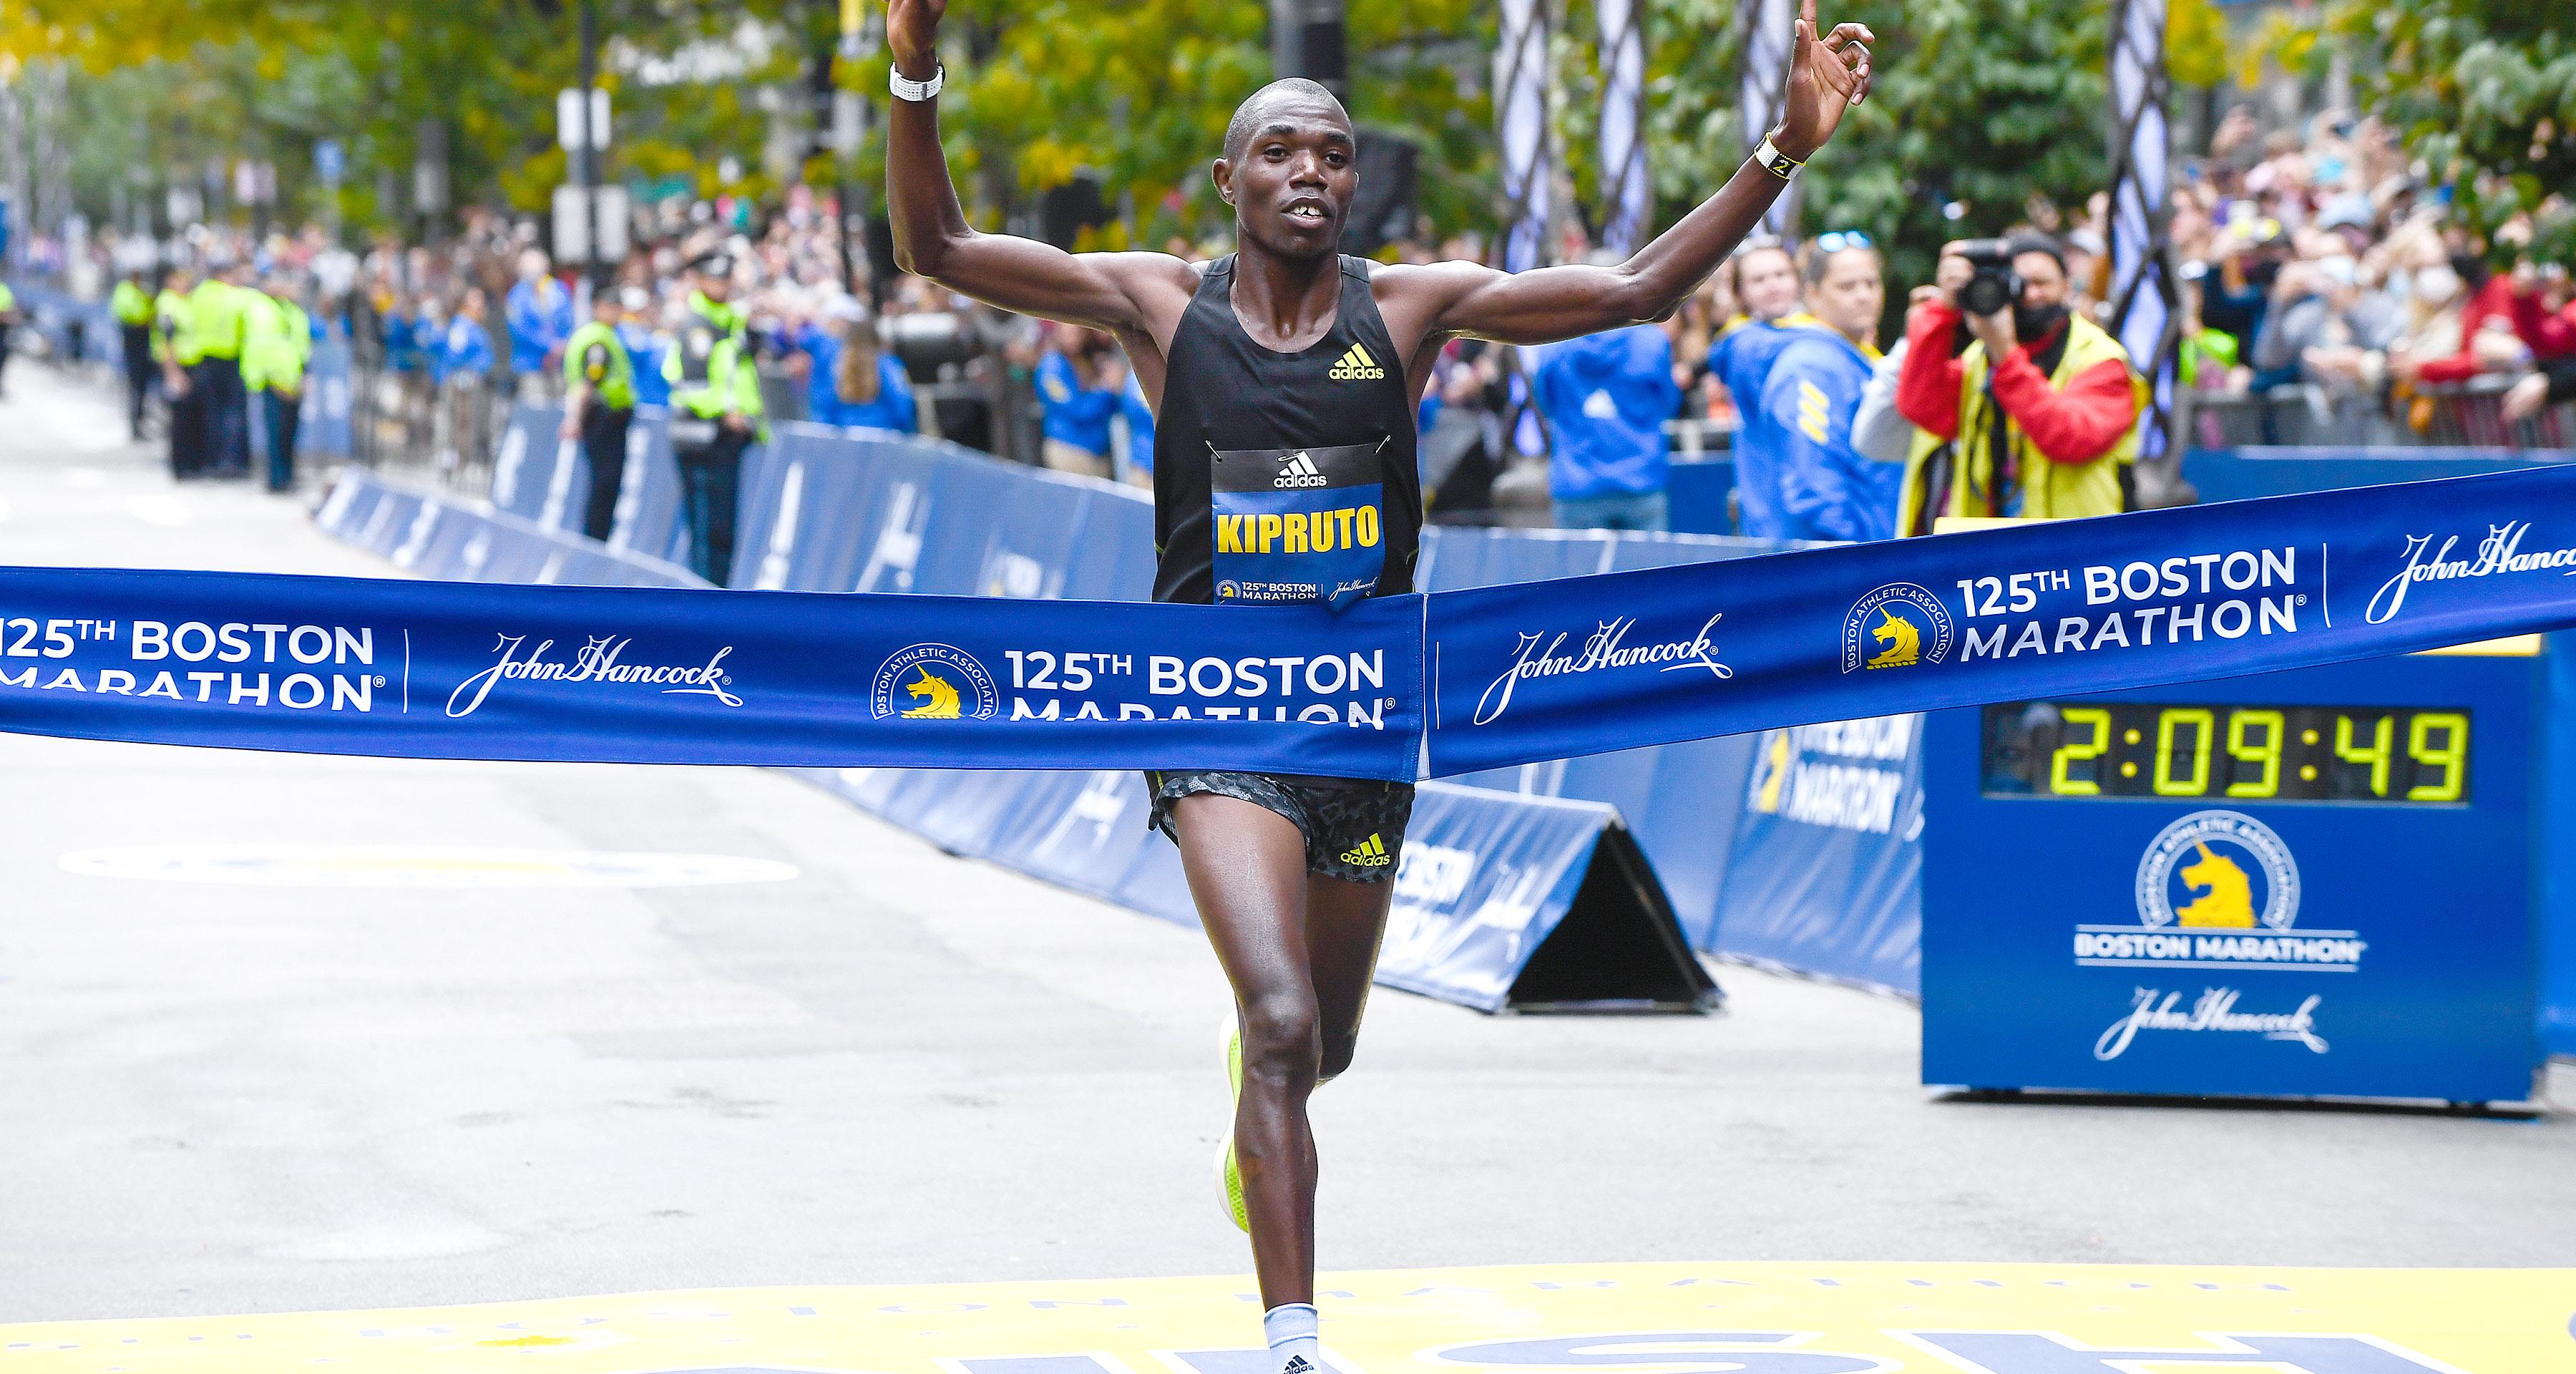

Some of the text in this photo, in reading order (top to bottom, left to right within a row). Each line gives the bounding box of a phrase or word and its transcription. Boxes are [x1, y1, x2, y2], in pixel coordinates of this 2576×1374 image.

[1329, 365, 1385, 380] adidas
[1274, 474, 1327, 488] adidas
[1218, 505, 1380, 554] KIPRUTO
[1241, 582, 1267, 591] 125TH
[1269, 583, 1316, 593] BOSTON
[1958, 547, 2296, 618] 125TH BOSTON
[2366, 533, 2471, 624] John
[132, 620, 373, 665] BOSTON
[1848, 588, 1949, 668] BOSTON ATHLETIC ASSOCIATION
[445, 632, 565, 718] John
[877, 671, 893, 715] BOSTON
[890, 648, 948, 673] ATHLETIC
[1005, 649, 1384, 697] 125TH BOSTON
[1474, 630, 1572, 726] John
[2051, 707, 2469, 802] 2:09:49
[1340, 852, 1390, 867] adidas
[2074, 933, 2191, 959] BOSTON
[1283, 1365, 1314, 1374] didas
